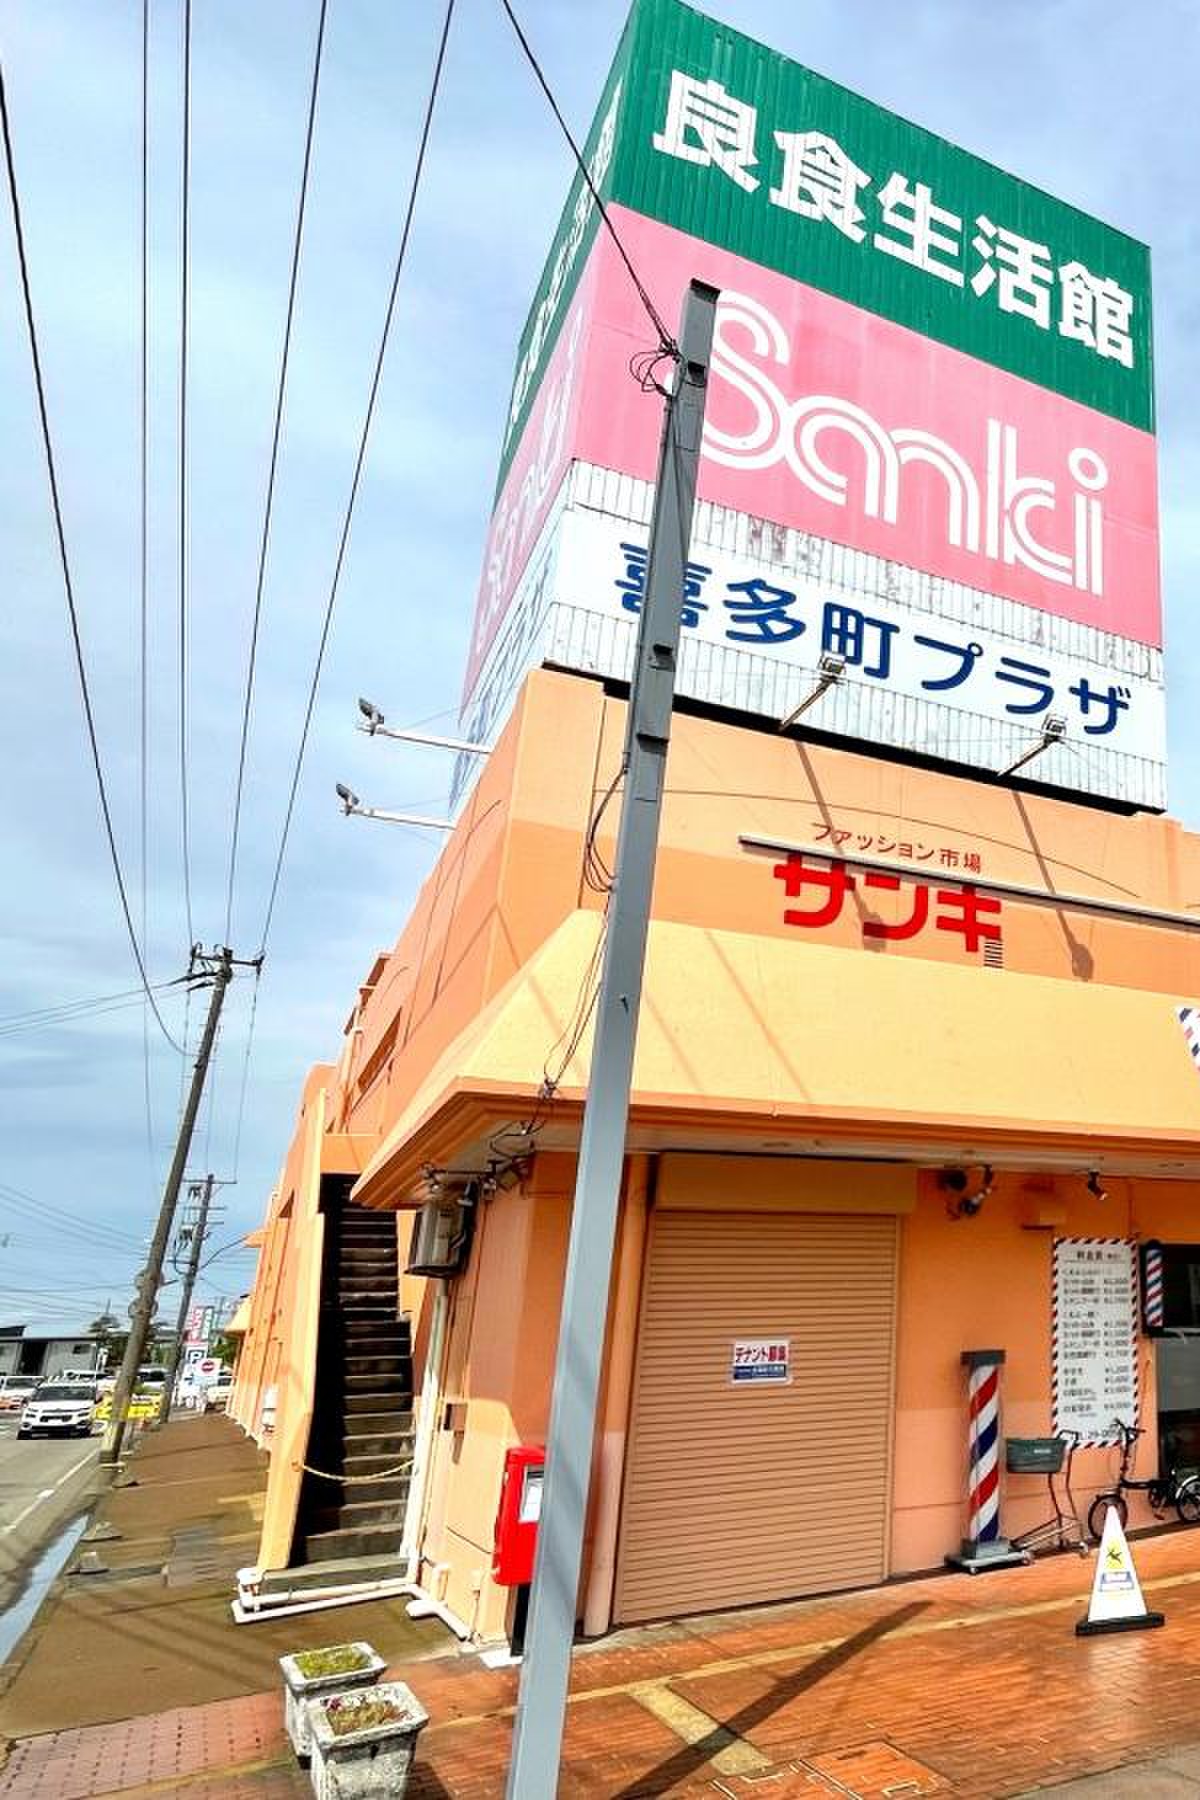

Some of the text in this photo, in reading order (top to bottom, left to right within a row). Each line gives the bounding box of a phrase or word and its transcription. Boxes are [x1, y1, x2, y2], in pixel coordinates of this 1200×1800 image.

[653, 70, 1136, 369] 良食生活館
[664, 289, 1107, 596] Sanki
[615, 541, 1132, 735] 喜多町プラザ
[773, 853, 1002, 953] サンキ
[811, 822, 981, 874] ファッション市場
